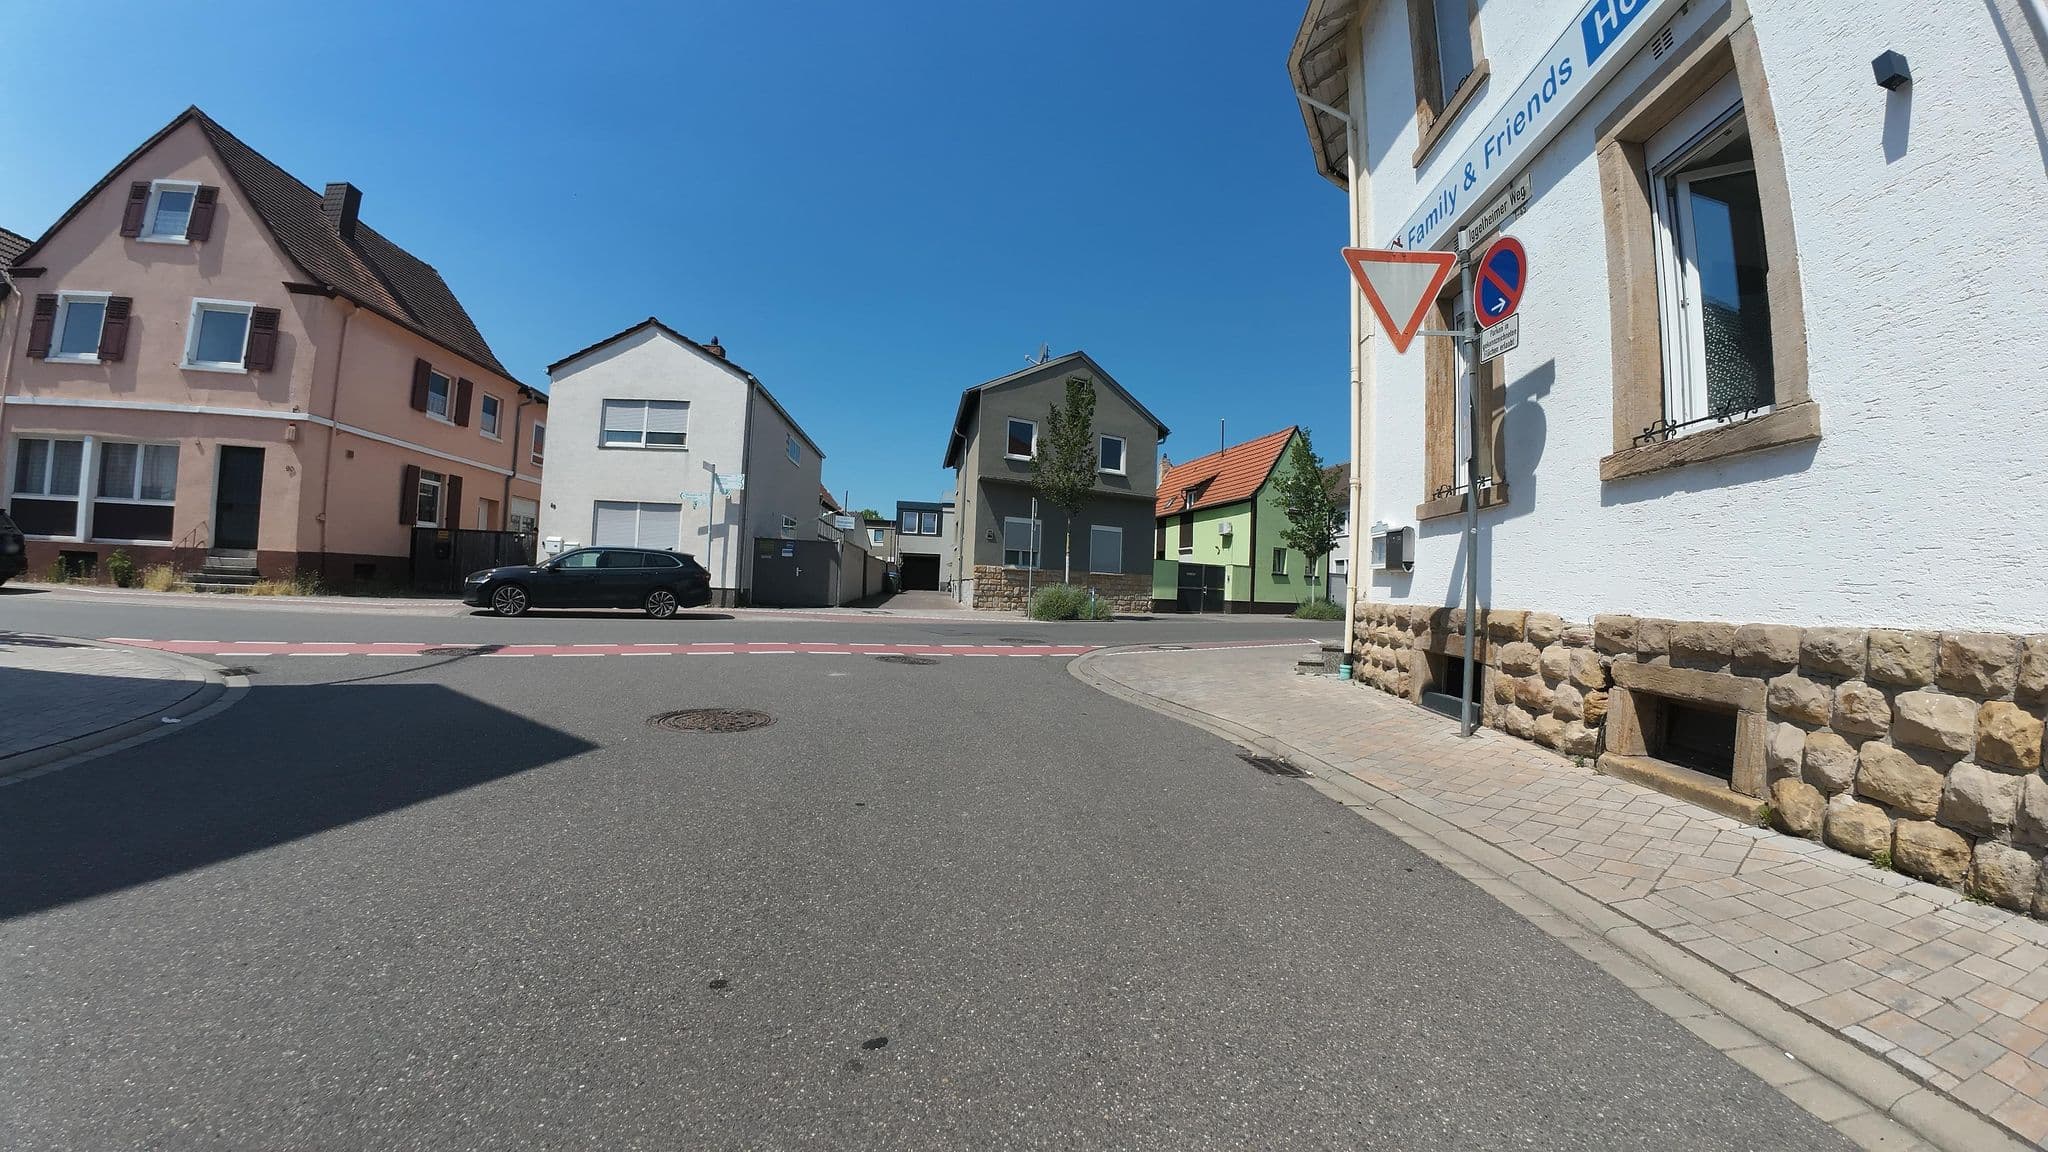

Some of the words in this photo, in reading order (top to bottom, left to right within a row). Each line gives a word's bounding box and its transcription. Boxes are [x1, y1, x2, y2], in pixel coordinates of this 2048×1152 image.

[1408, 184, 1458, 250] Family
[1463, 161, 1477, 191] &
[1484, 57, 1573, 170] Friends
[1468, 201, 1508, 243] Iggelheimer
[1509, 186, 1526, 206] Weg
